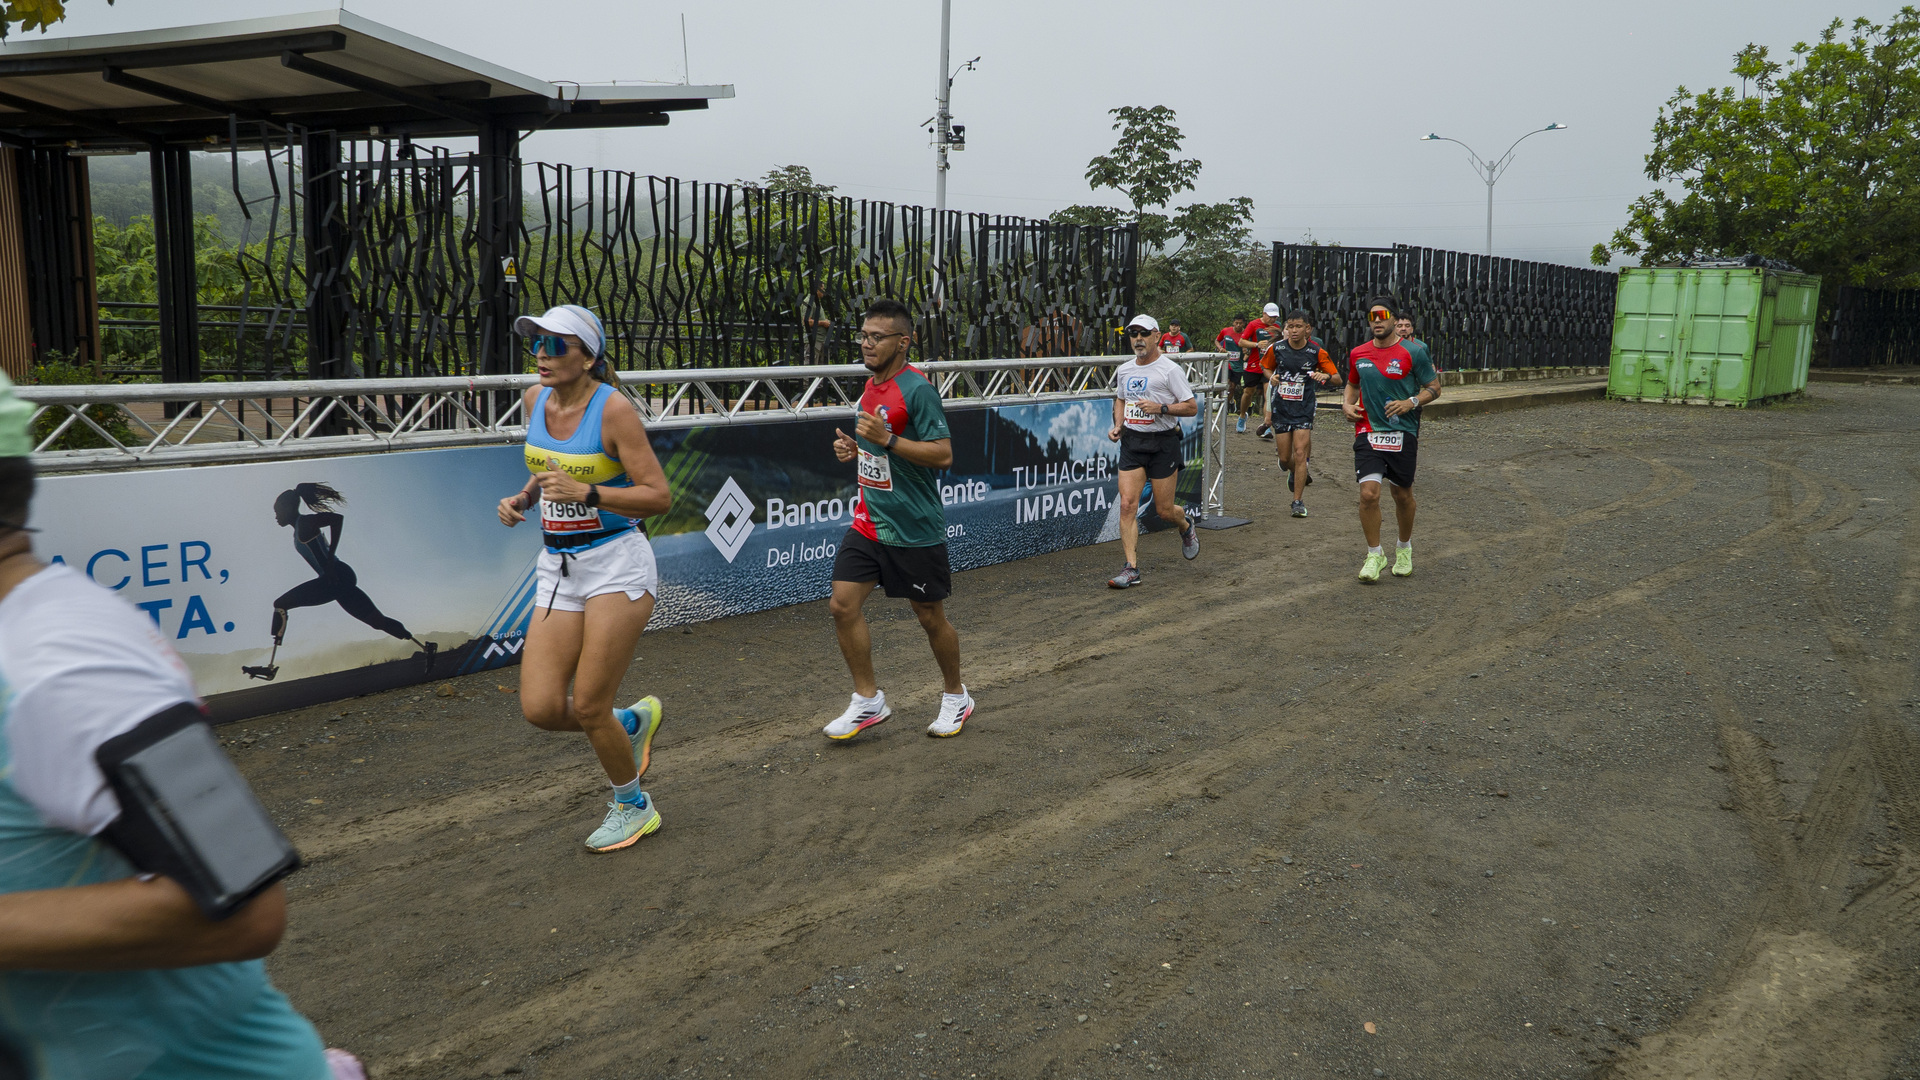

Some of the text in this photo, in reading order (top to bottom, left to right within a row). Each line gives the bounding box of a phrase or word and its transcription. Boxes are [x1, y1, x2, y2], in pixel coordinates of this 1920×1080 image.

[1283, 387, 1300, 395] 1988
[1373, 436, 1397, 444] 1790
[859, 463, 881, 479] 1623
[1013, 456, 1112, 492] TU HACER,
[548, 502, 587, 518] 1960
[767, 497, 843, 530] Banco
[1016, 487, 1112, 524] IMPACTA.
[767, 543, 795, 567] Del
[800, 538, 836, 563] lado
[492, 629, 522, 641] Grupo
